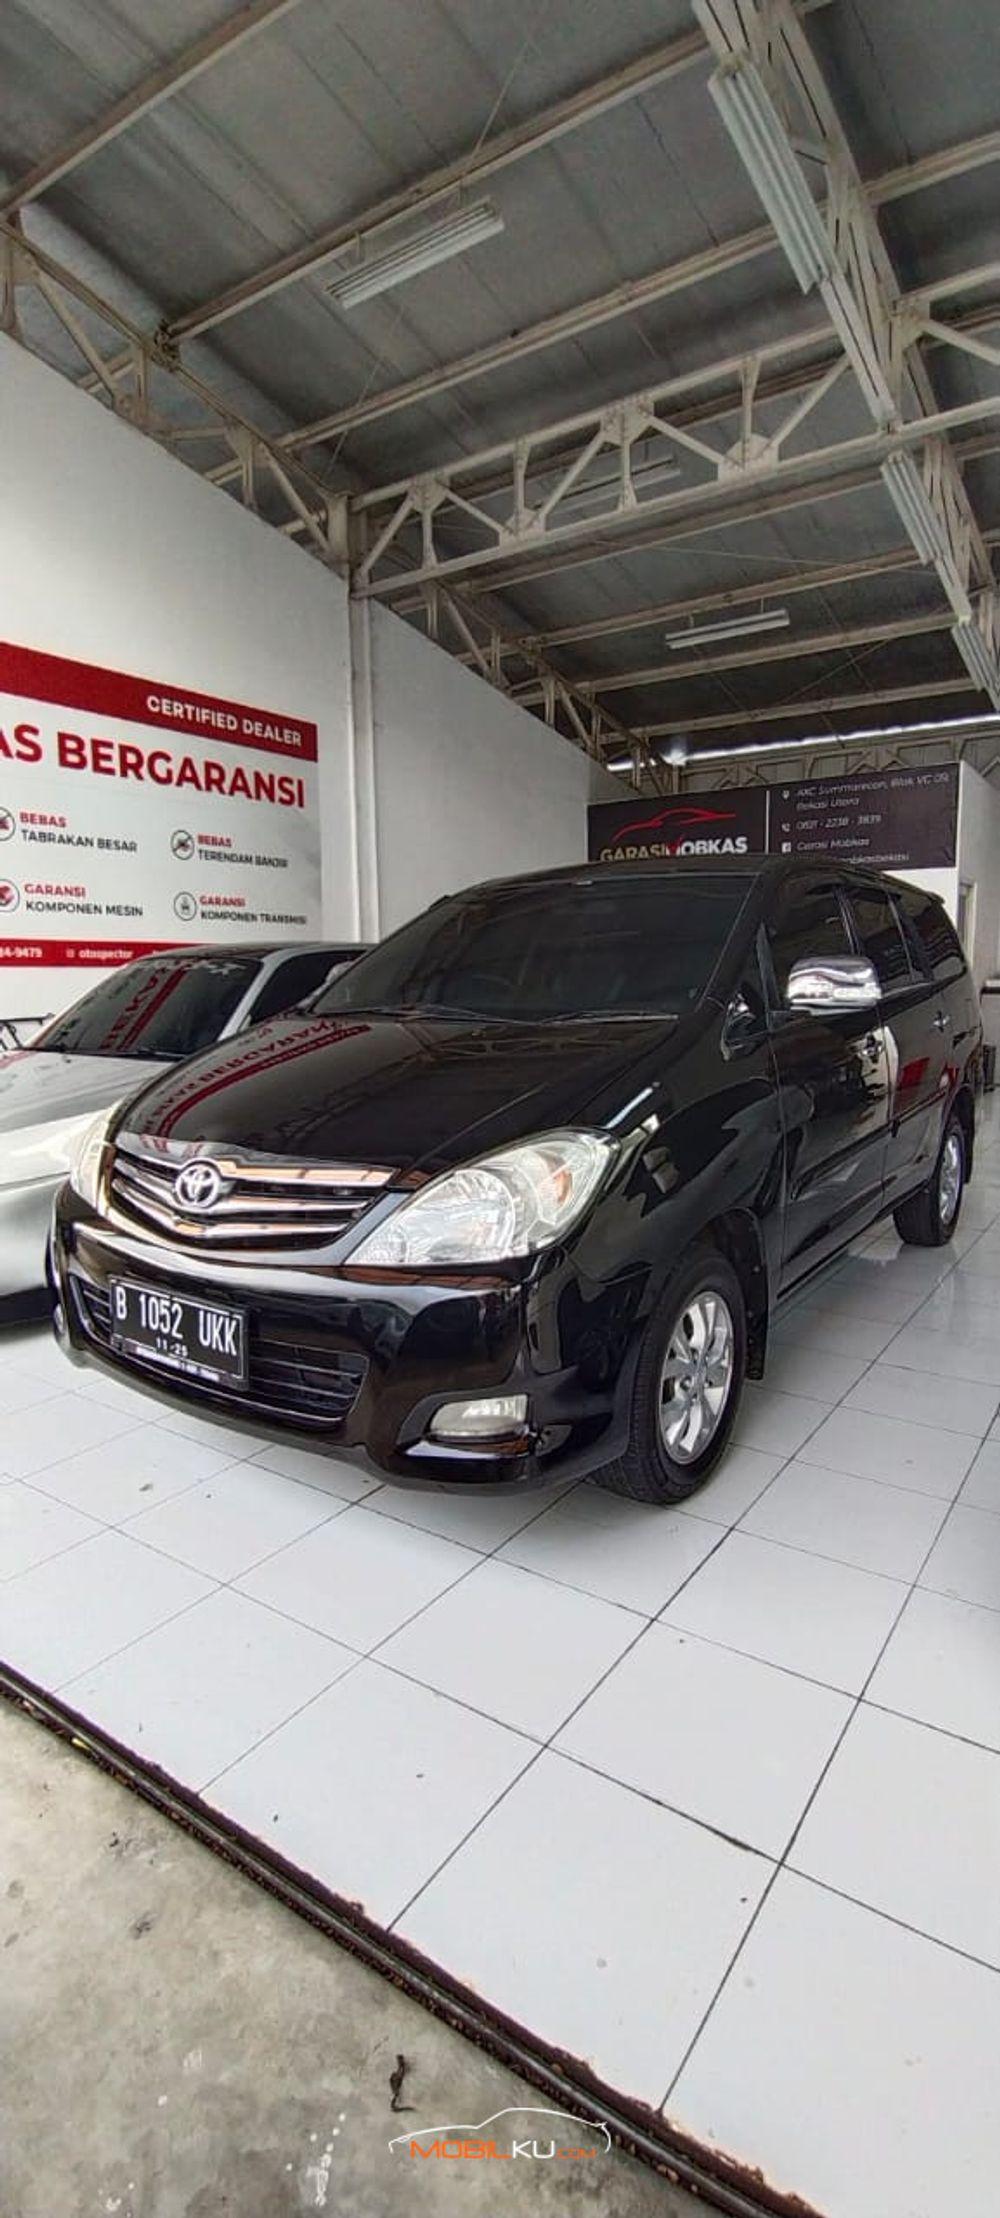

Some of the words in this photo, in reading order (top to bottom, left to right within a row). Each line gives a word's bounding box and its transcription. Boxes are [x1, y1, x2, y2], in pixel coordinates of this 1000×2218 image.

[147, 695, 237, 730] CERTIFIED
[242, 720, 302, 747] DEALER
[57, 731, 304, 808] BERGARANSI
[20, 812, 66, 828] BEBAS
[21, 829, 94, 848] TABRAKAN
[97, 838, 138, 852] BESAR
[198, 835, 232, 848] BEBAS
[198, 849, 253, 865] TERENDAM
[24, 883, 86, 897] GARANSI
[26, 900, 103, 915] KOMPONEN
[105, 904, 143, 917] MESIN
[200, 895, 246, 907] GARANSI
[201, 910, 257, 922] KOMPONEN
[115, 1285, 128, 1320] B
[140, 1293, 183, 1340] 1052
[199, 1309, 237, 1356] UKK
